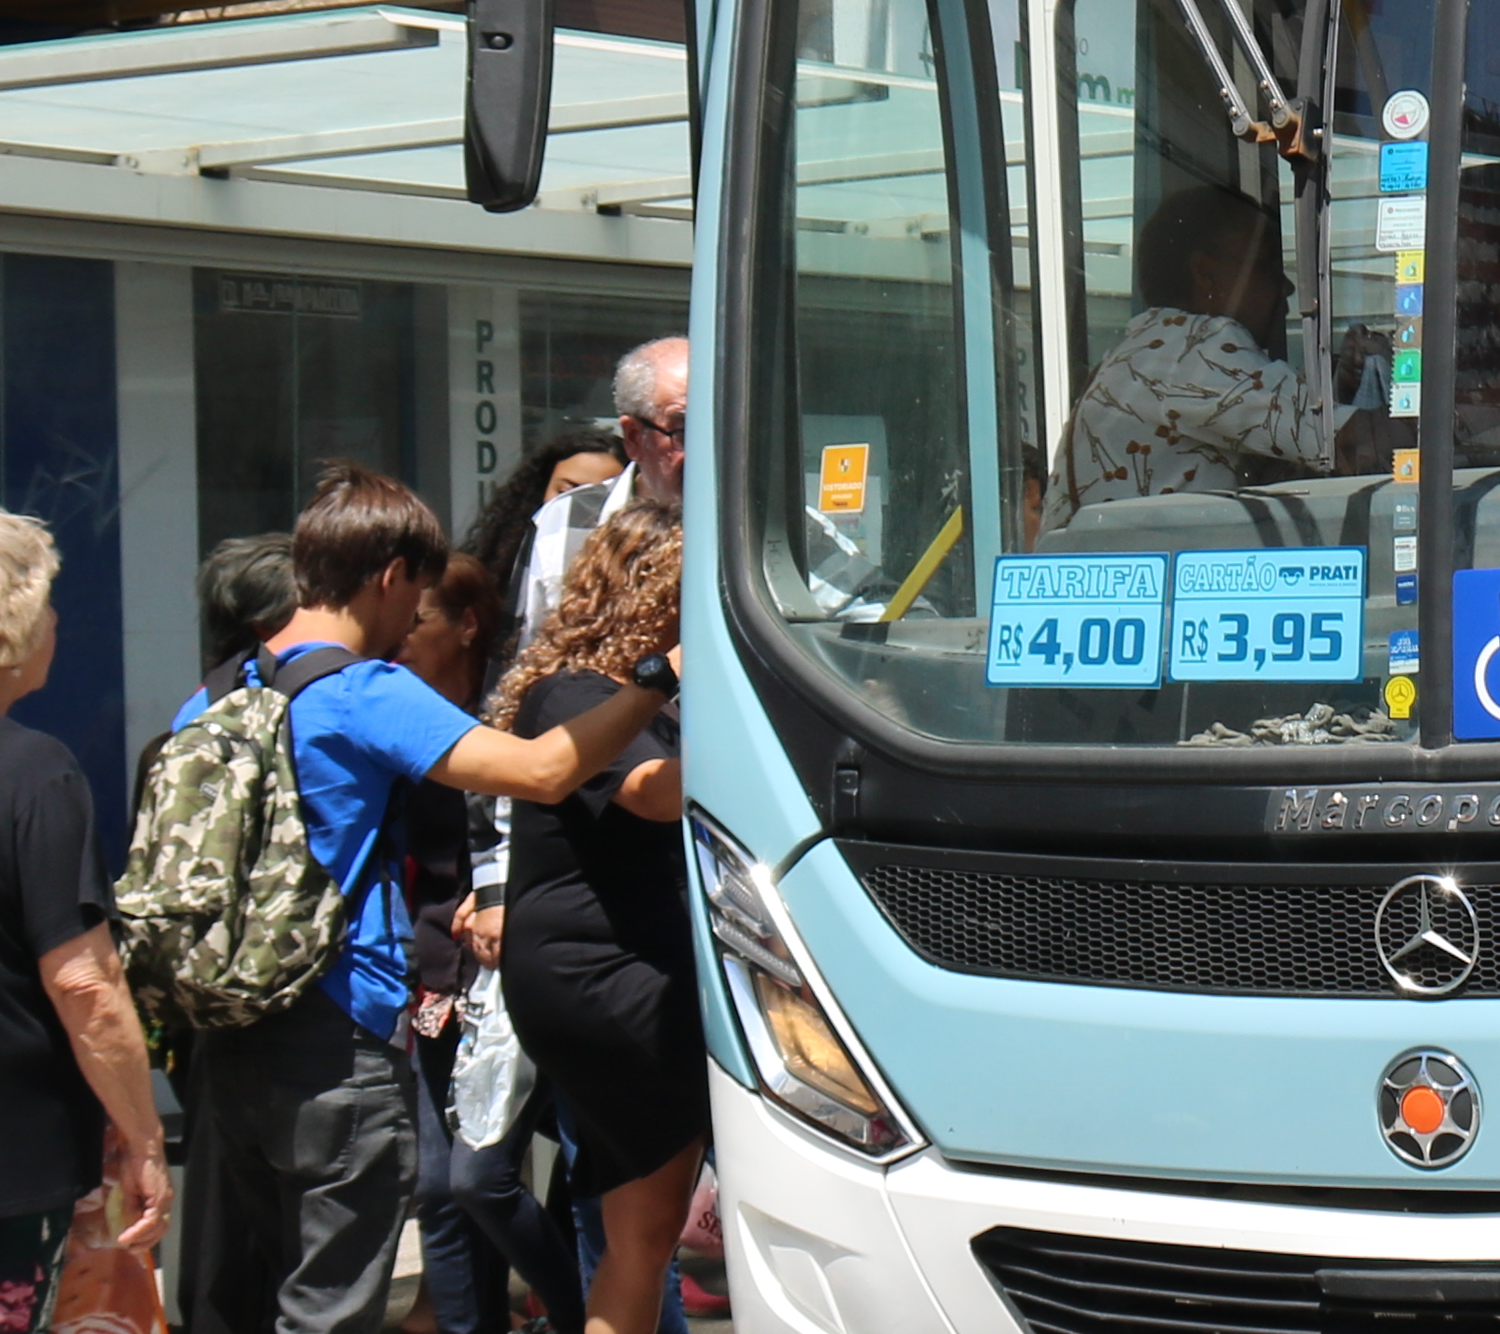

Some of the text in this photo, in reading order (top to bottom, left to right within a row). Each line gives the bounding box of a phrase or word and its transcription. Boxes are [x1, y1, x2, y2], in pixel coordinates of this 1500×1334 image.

[1001, 564, 1158, 599] TARIFA
[1178, 555, 1358, 593] CARTÃO PRATI
[996, 617, 1146, 675] R$ 4,00
[1179, 616, 1209, 663] R$
[1216, 612, 1344, 672] 3,95
